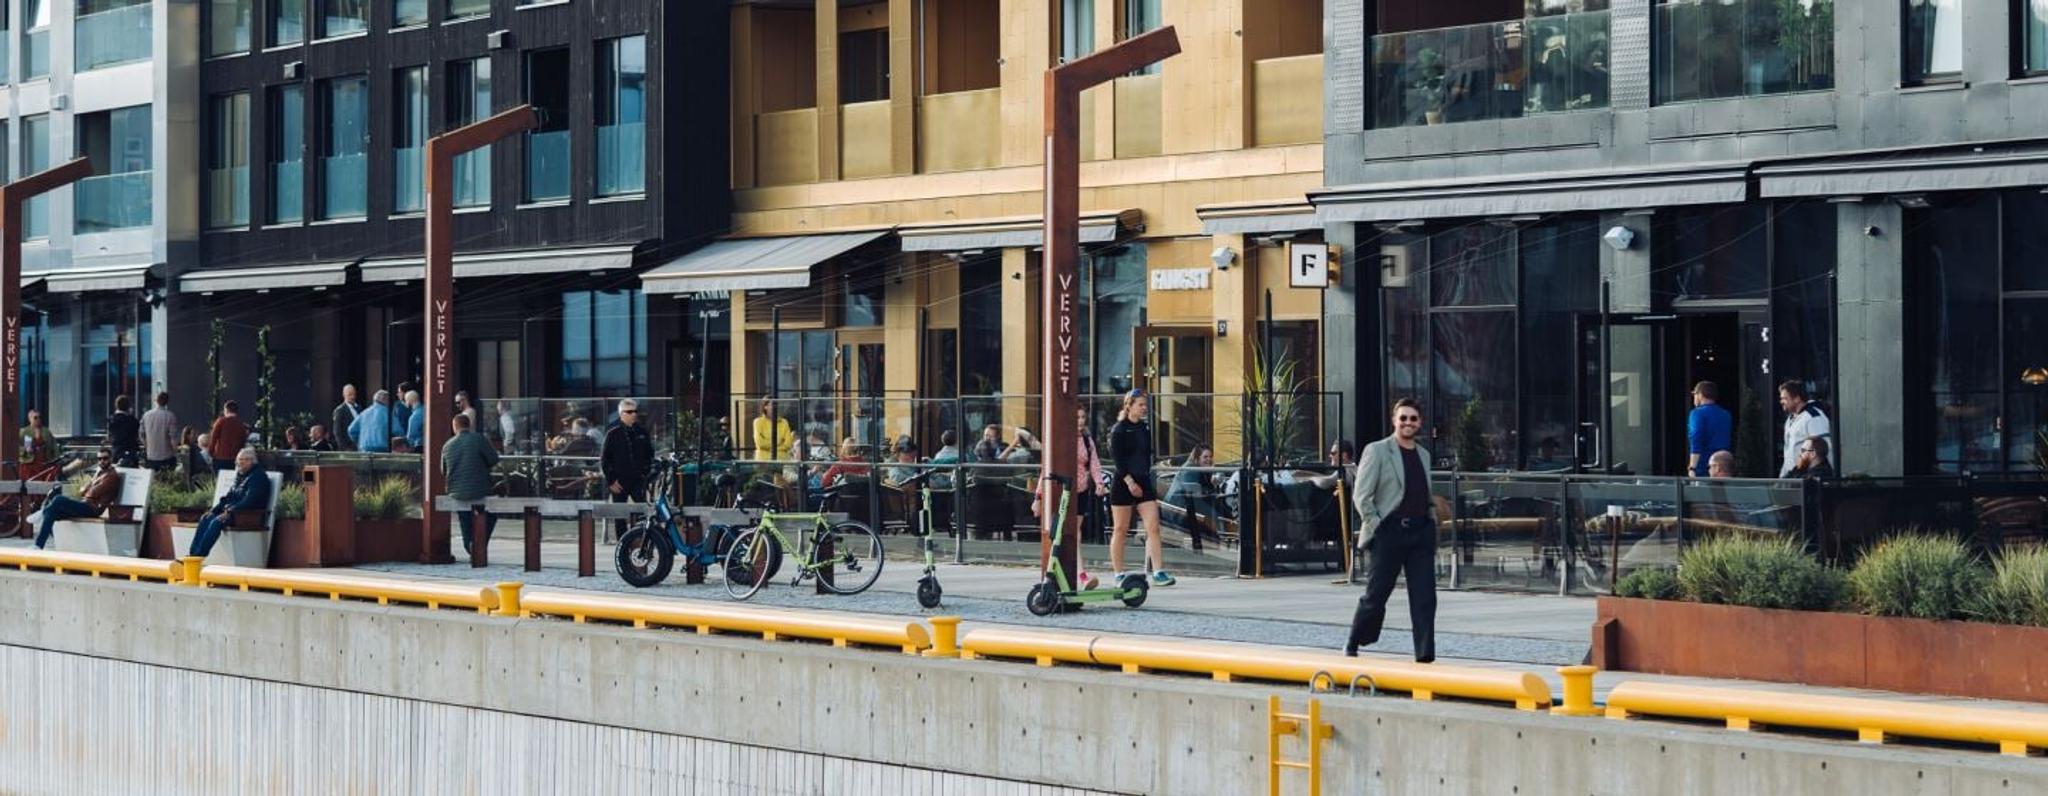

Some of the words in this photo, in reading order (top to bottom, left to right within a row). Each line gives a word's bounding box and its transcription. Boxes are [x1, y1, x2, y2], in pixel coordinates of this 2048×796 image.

[1301, 253, 1317, 276] F
[6, 316, 17, 392] VERVET
[436, 300, 447, 393] VERVET
[1058, 273, 1073, 394] VERVET
